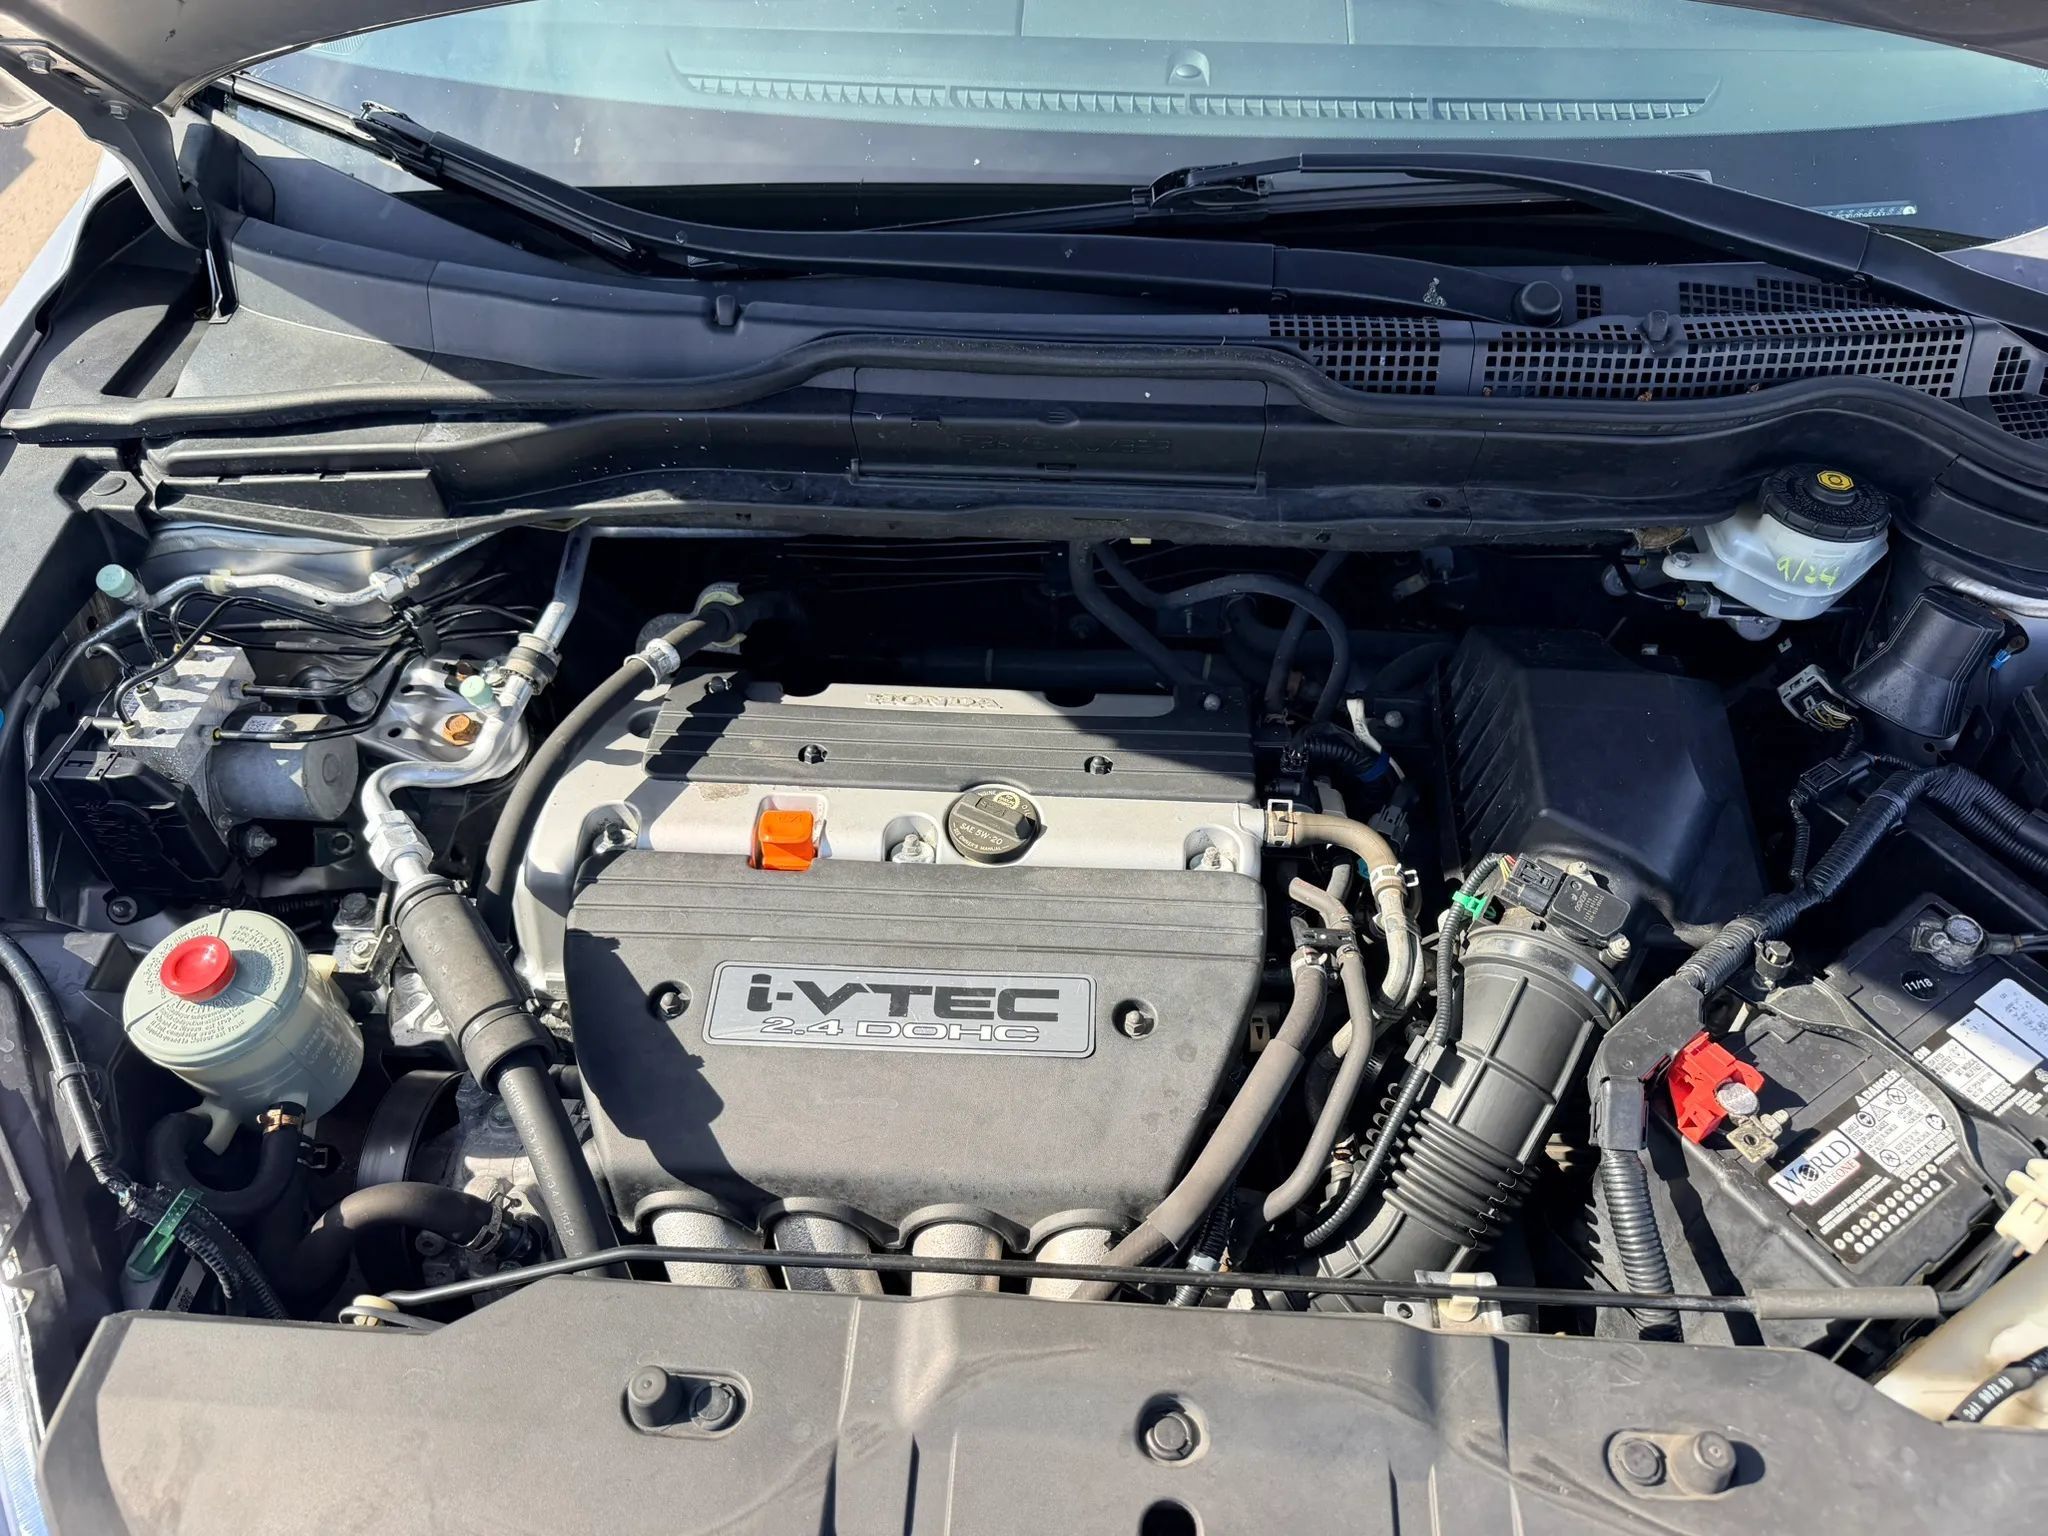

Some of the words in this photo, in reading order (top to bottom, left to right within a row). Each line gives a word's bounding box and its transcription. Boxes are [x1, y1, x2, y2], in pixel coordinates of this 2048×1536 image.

[867, 692, 1004, 710] HONDA
[960, 822, 976, 834] SAE
[975, 828, 1003, 845] 5W-20
[747, 973, 1060, 1022] i-VTEC
[1904, 978, 1934, 991] 11/18
[760, 1017, 844, 1037] 2.4
[855, 1020, 1040, 1043] DOHC
[1866, 1068, 1902, 1100] DANGER
[1804, 1159, 1860, 1202] SOURCEONE
